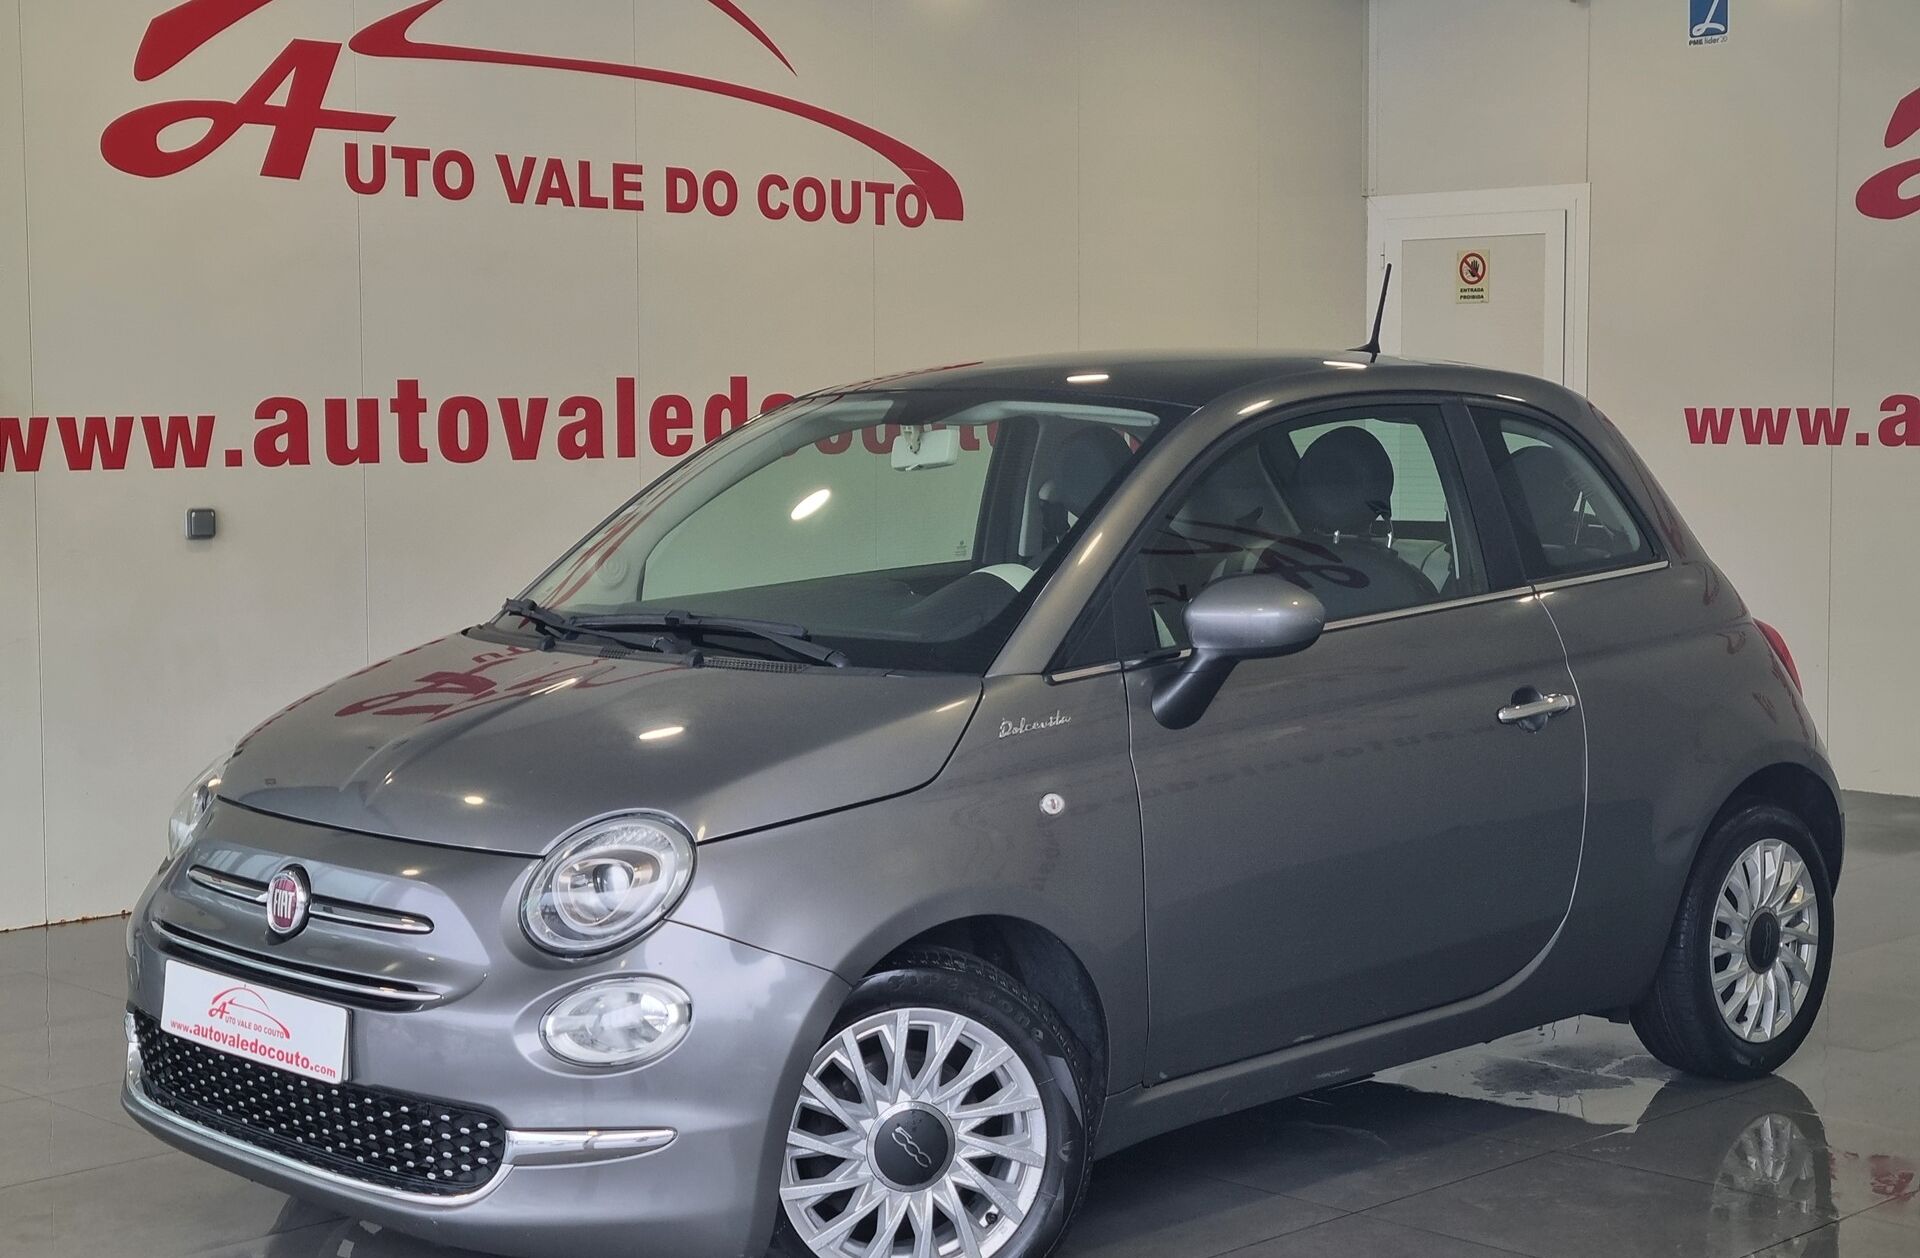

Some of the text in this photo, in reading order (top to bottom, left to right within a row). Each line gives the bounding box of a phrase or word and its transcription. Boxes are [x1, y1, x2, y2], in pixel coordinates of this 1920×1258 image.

[101, 38, 928, 228] AUTO VALE DO COUTO
[273, 888, 296, 920] FIAT
[170, 1019, 337, 1079] www.autovaledocouto.com
[237, 1019, 252, 1030] VALE
[254, 1022, 263, 1033] DO
[263, 1026, 285, 1040] COUTO
